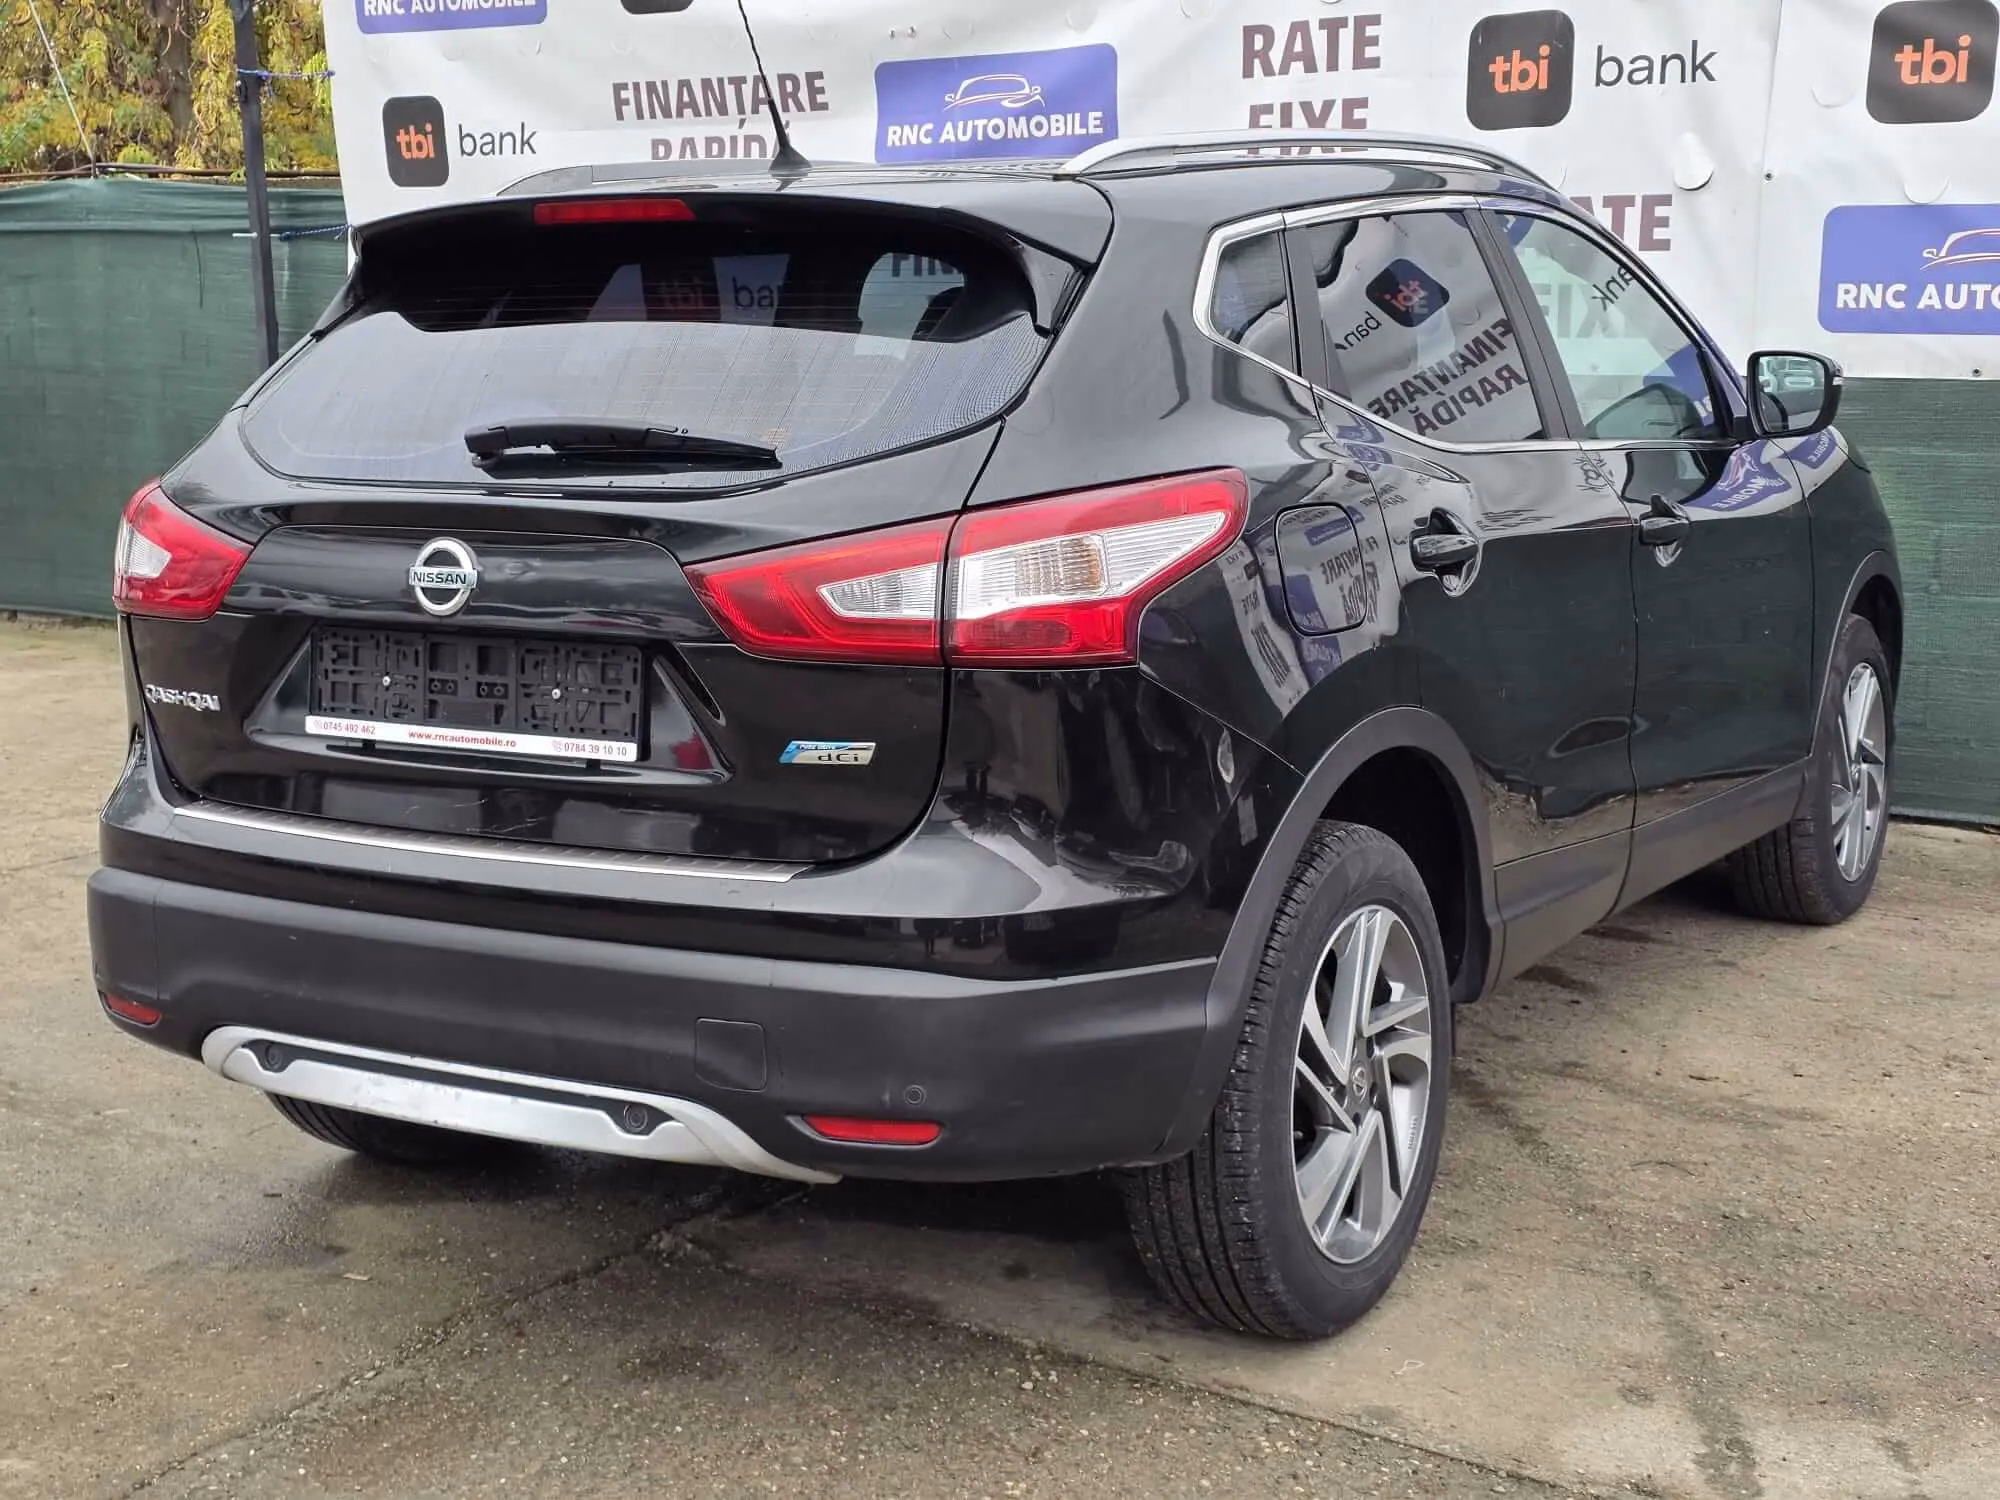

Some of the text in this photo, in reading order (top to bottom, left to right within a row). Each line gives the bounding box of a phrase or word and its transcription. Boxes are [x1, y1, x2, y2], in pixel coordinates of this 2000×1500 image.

[1242, 14, 1382, 78] RATE
[1895, 34, 1972, 85] tbi
[1489, 41, 1718, 94] tbi bank
[396, 124, 537, 160] tbi bank
[651, 125, 789, 161] RAPID
[887, 112, 1104, 146] RNC AUTOMOBILE
[1836, 283, 1907, 309] RNC
[413, 571, 467, 585] NISSAN
[323, 721, 343, 732] 0745
[408, 729, 517, 748] www.rncautomobile.ro
[564, 742, 586, 753] 0784
[603, 745, 614, 755] 10
[617, 746, 628, 756] 10
